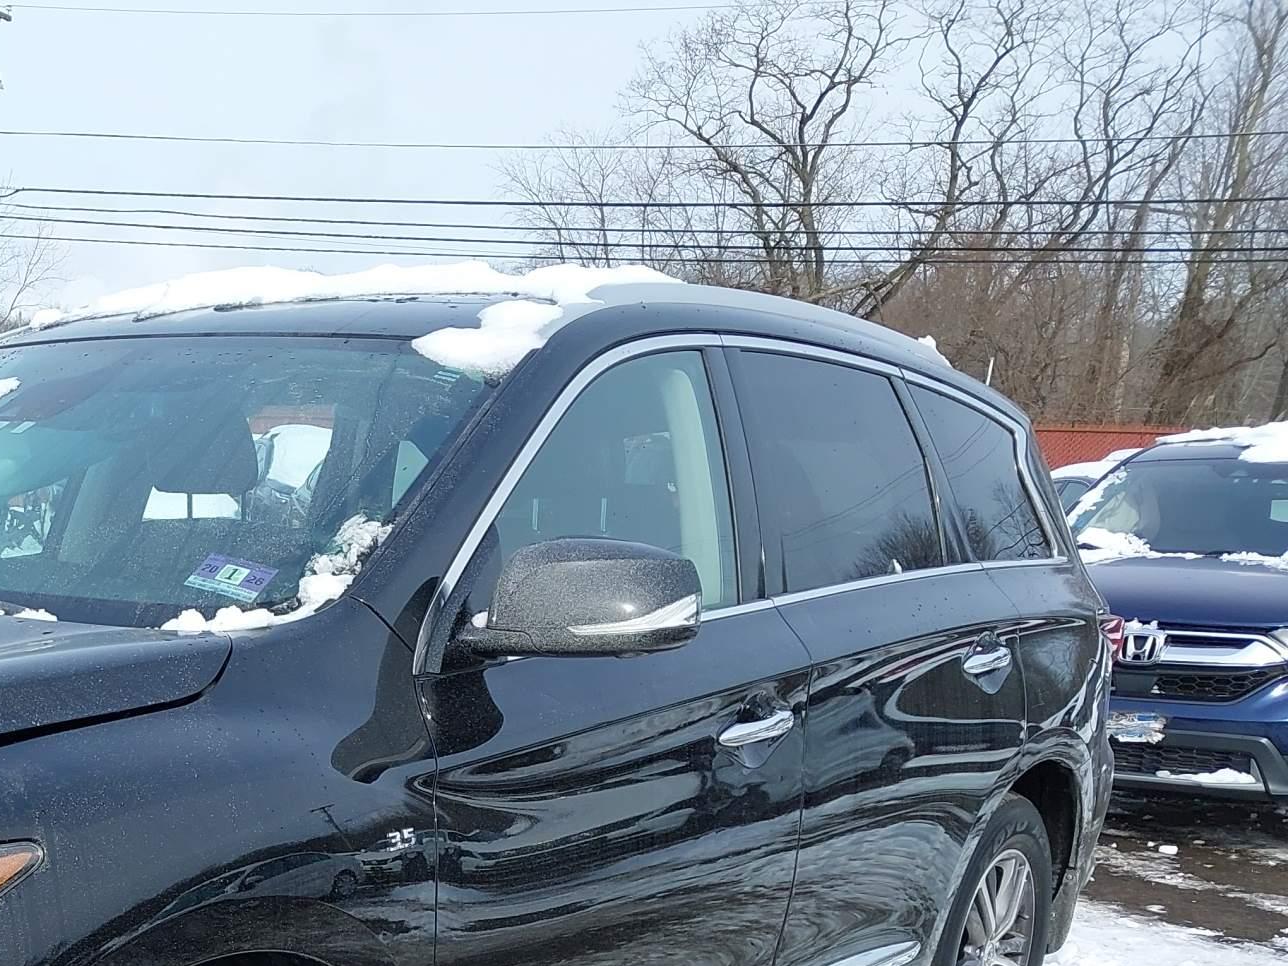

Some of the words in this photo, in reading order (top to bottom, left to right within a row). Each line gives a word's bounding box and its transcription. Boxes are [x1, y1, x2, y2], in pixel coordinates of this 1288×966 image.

[202, 563, 219, 574] 20
[224, 568, 239, 581] 1
[245, 575, 265, 586] 26
